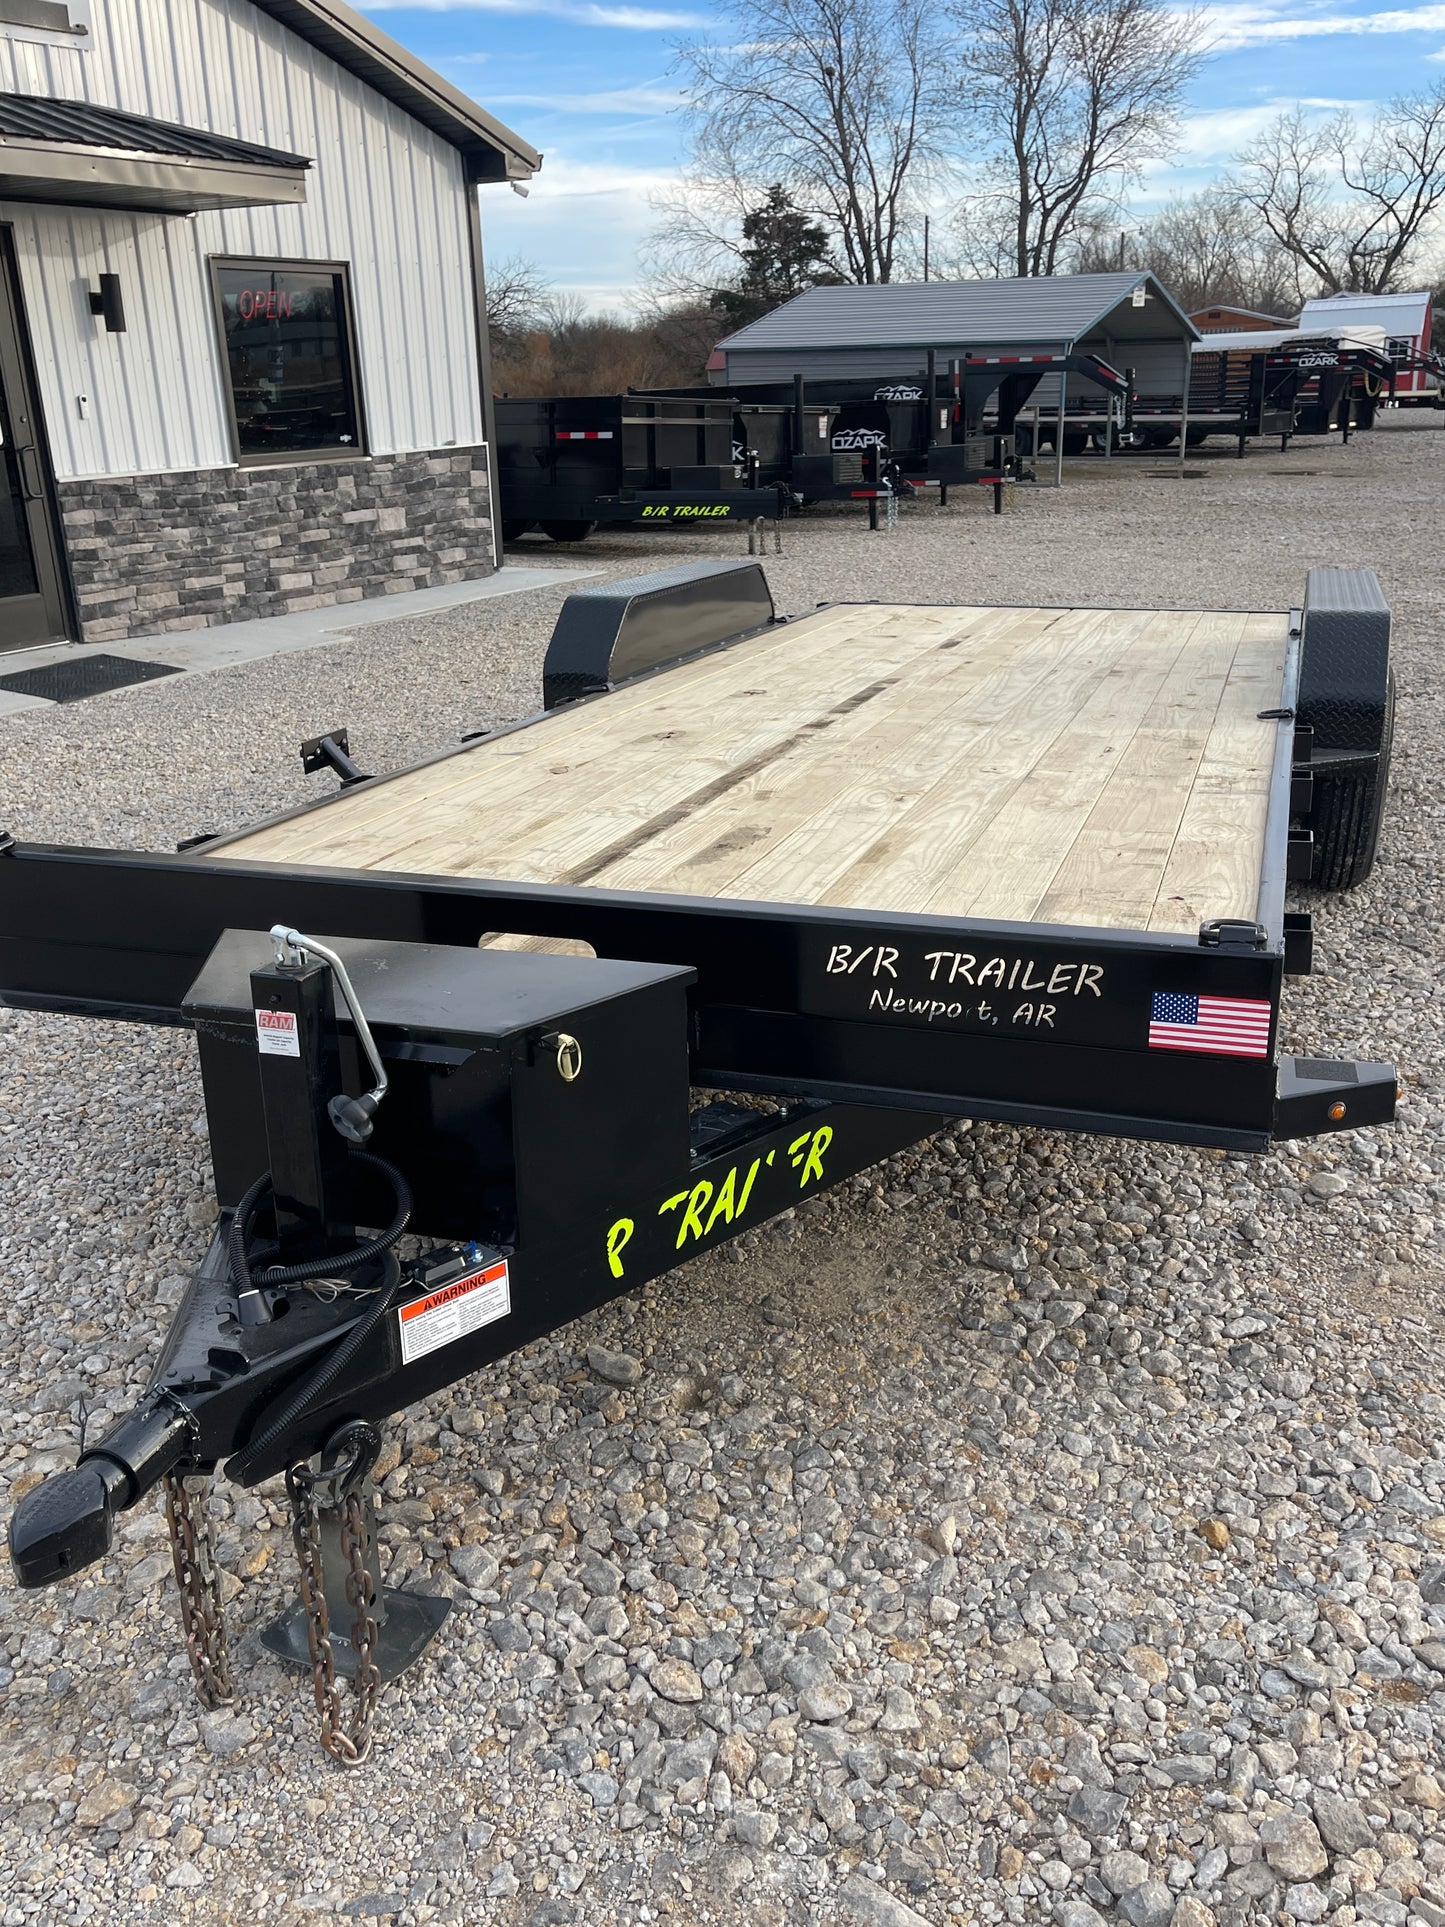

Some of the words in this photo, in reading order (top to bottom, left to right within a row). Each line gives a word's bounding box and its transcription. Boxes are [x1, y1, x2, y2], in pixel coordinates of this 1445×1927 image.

[240, 290, 292, 320] OPEN
[1299, 356, 1339, 367] OZARK
[832, 435, 888, 449] OZARK
[641, 506, 669, 517] B/R
[673, 505, 731, 517] TRAILER
[826, 944, 900, 979] B/R
[924, 951, 1105, 997] TRAILER
[868, 987, 999, 1026] Newpot,
[1012, 1002, 1058, 1029] AR
[260, 1015, 293, 1030] RAM
[431, 1275, 487, 1306] WARNING
